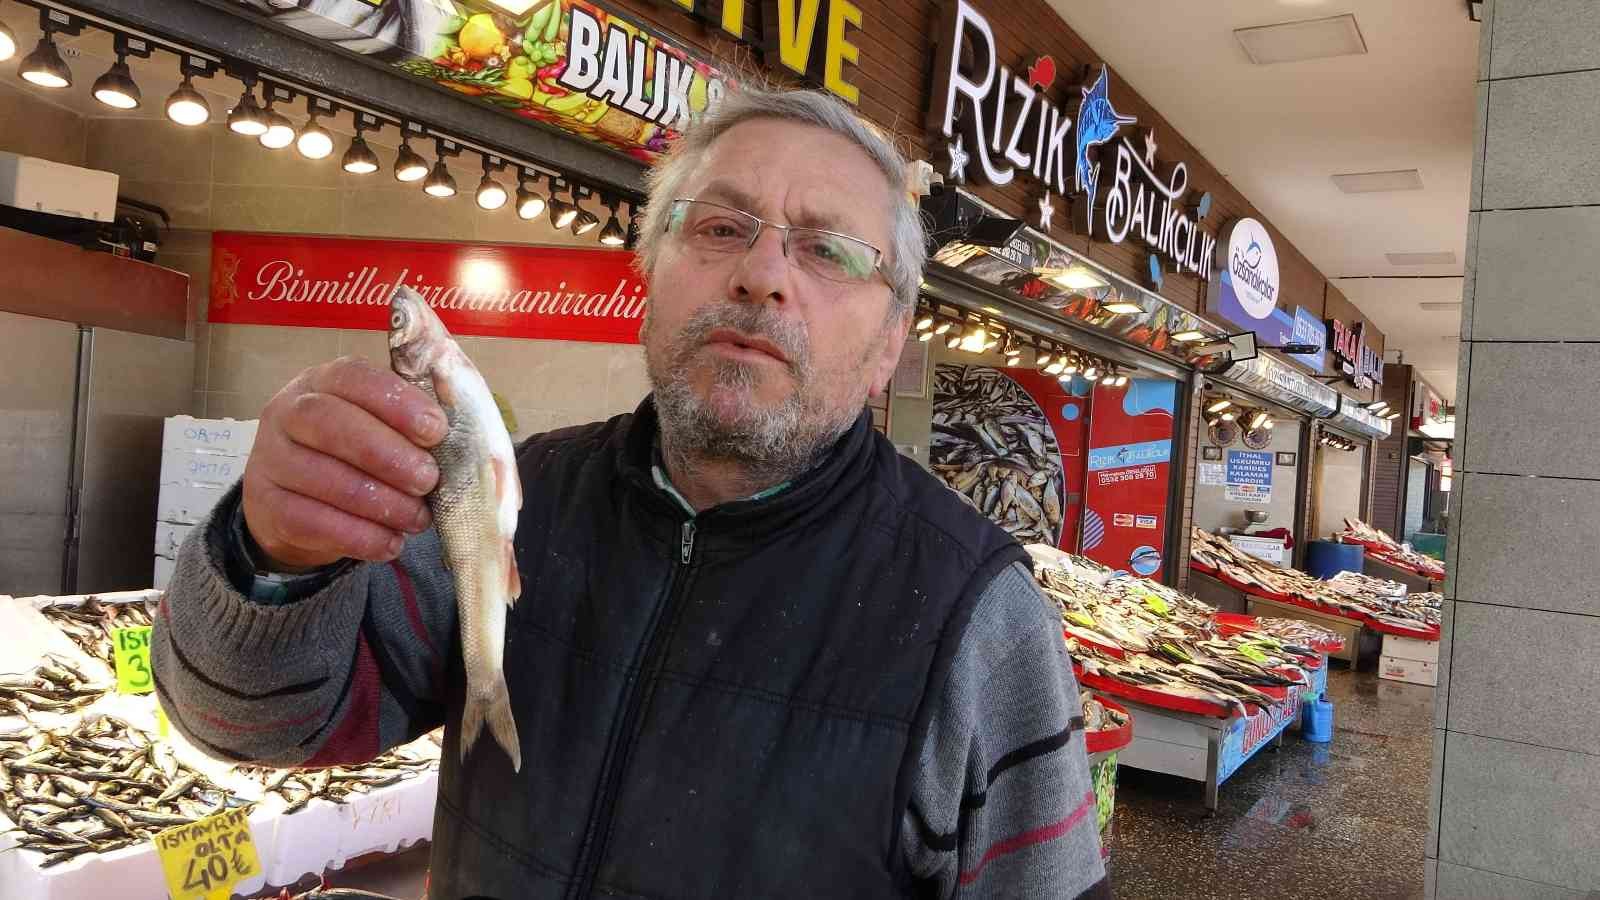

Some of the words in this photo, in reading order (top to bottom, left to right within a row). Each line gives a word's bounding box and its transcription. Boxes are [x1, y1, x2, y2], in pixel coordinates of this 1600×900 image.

[558, 5, 696, 126] BALIK
[943, 0, 1072, 194] RIZIK
[1105, 136, 1216, 281] BALIKÇILIK
